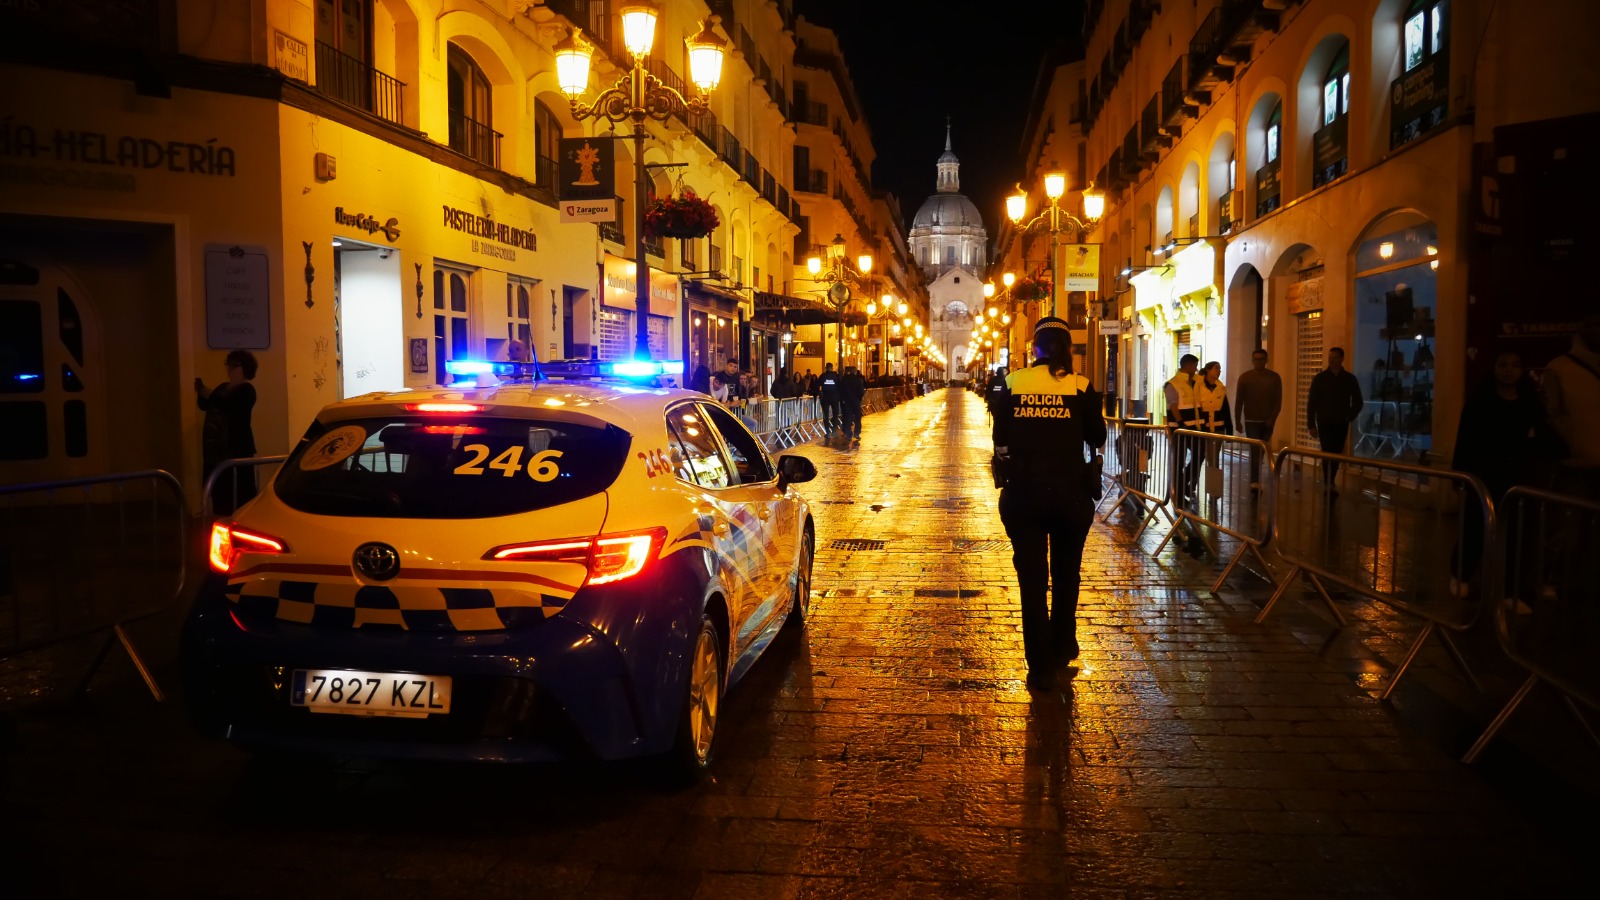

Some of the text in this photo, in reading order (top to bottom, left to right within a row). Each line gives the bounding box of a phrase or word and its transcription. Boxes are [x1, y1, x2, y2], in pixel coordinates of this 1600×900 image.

[0, 116, 236, 177] ÍA-HELADERÍA
[576, 206, 608, 215] Zaragoza
[442, 204, 537, 252] PASTELERÍA-HELADERÍA
[1013, 406, 1071, 419] ZARAGOZA
[1020, 394, 1064, 406] POLICIA
[453, 443, 564, 483] 246
[637, 447, 672, 479] 246
[310, 675, 444, 709] 7827 KZL
